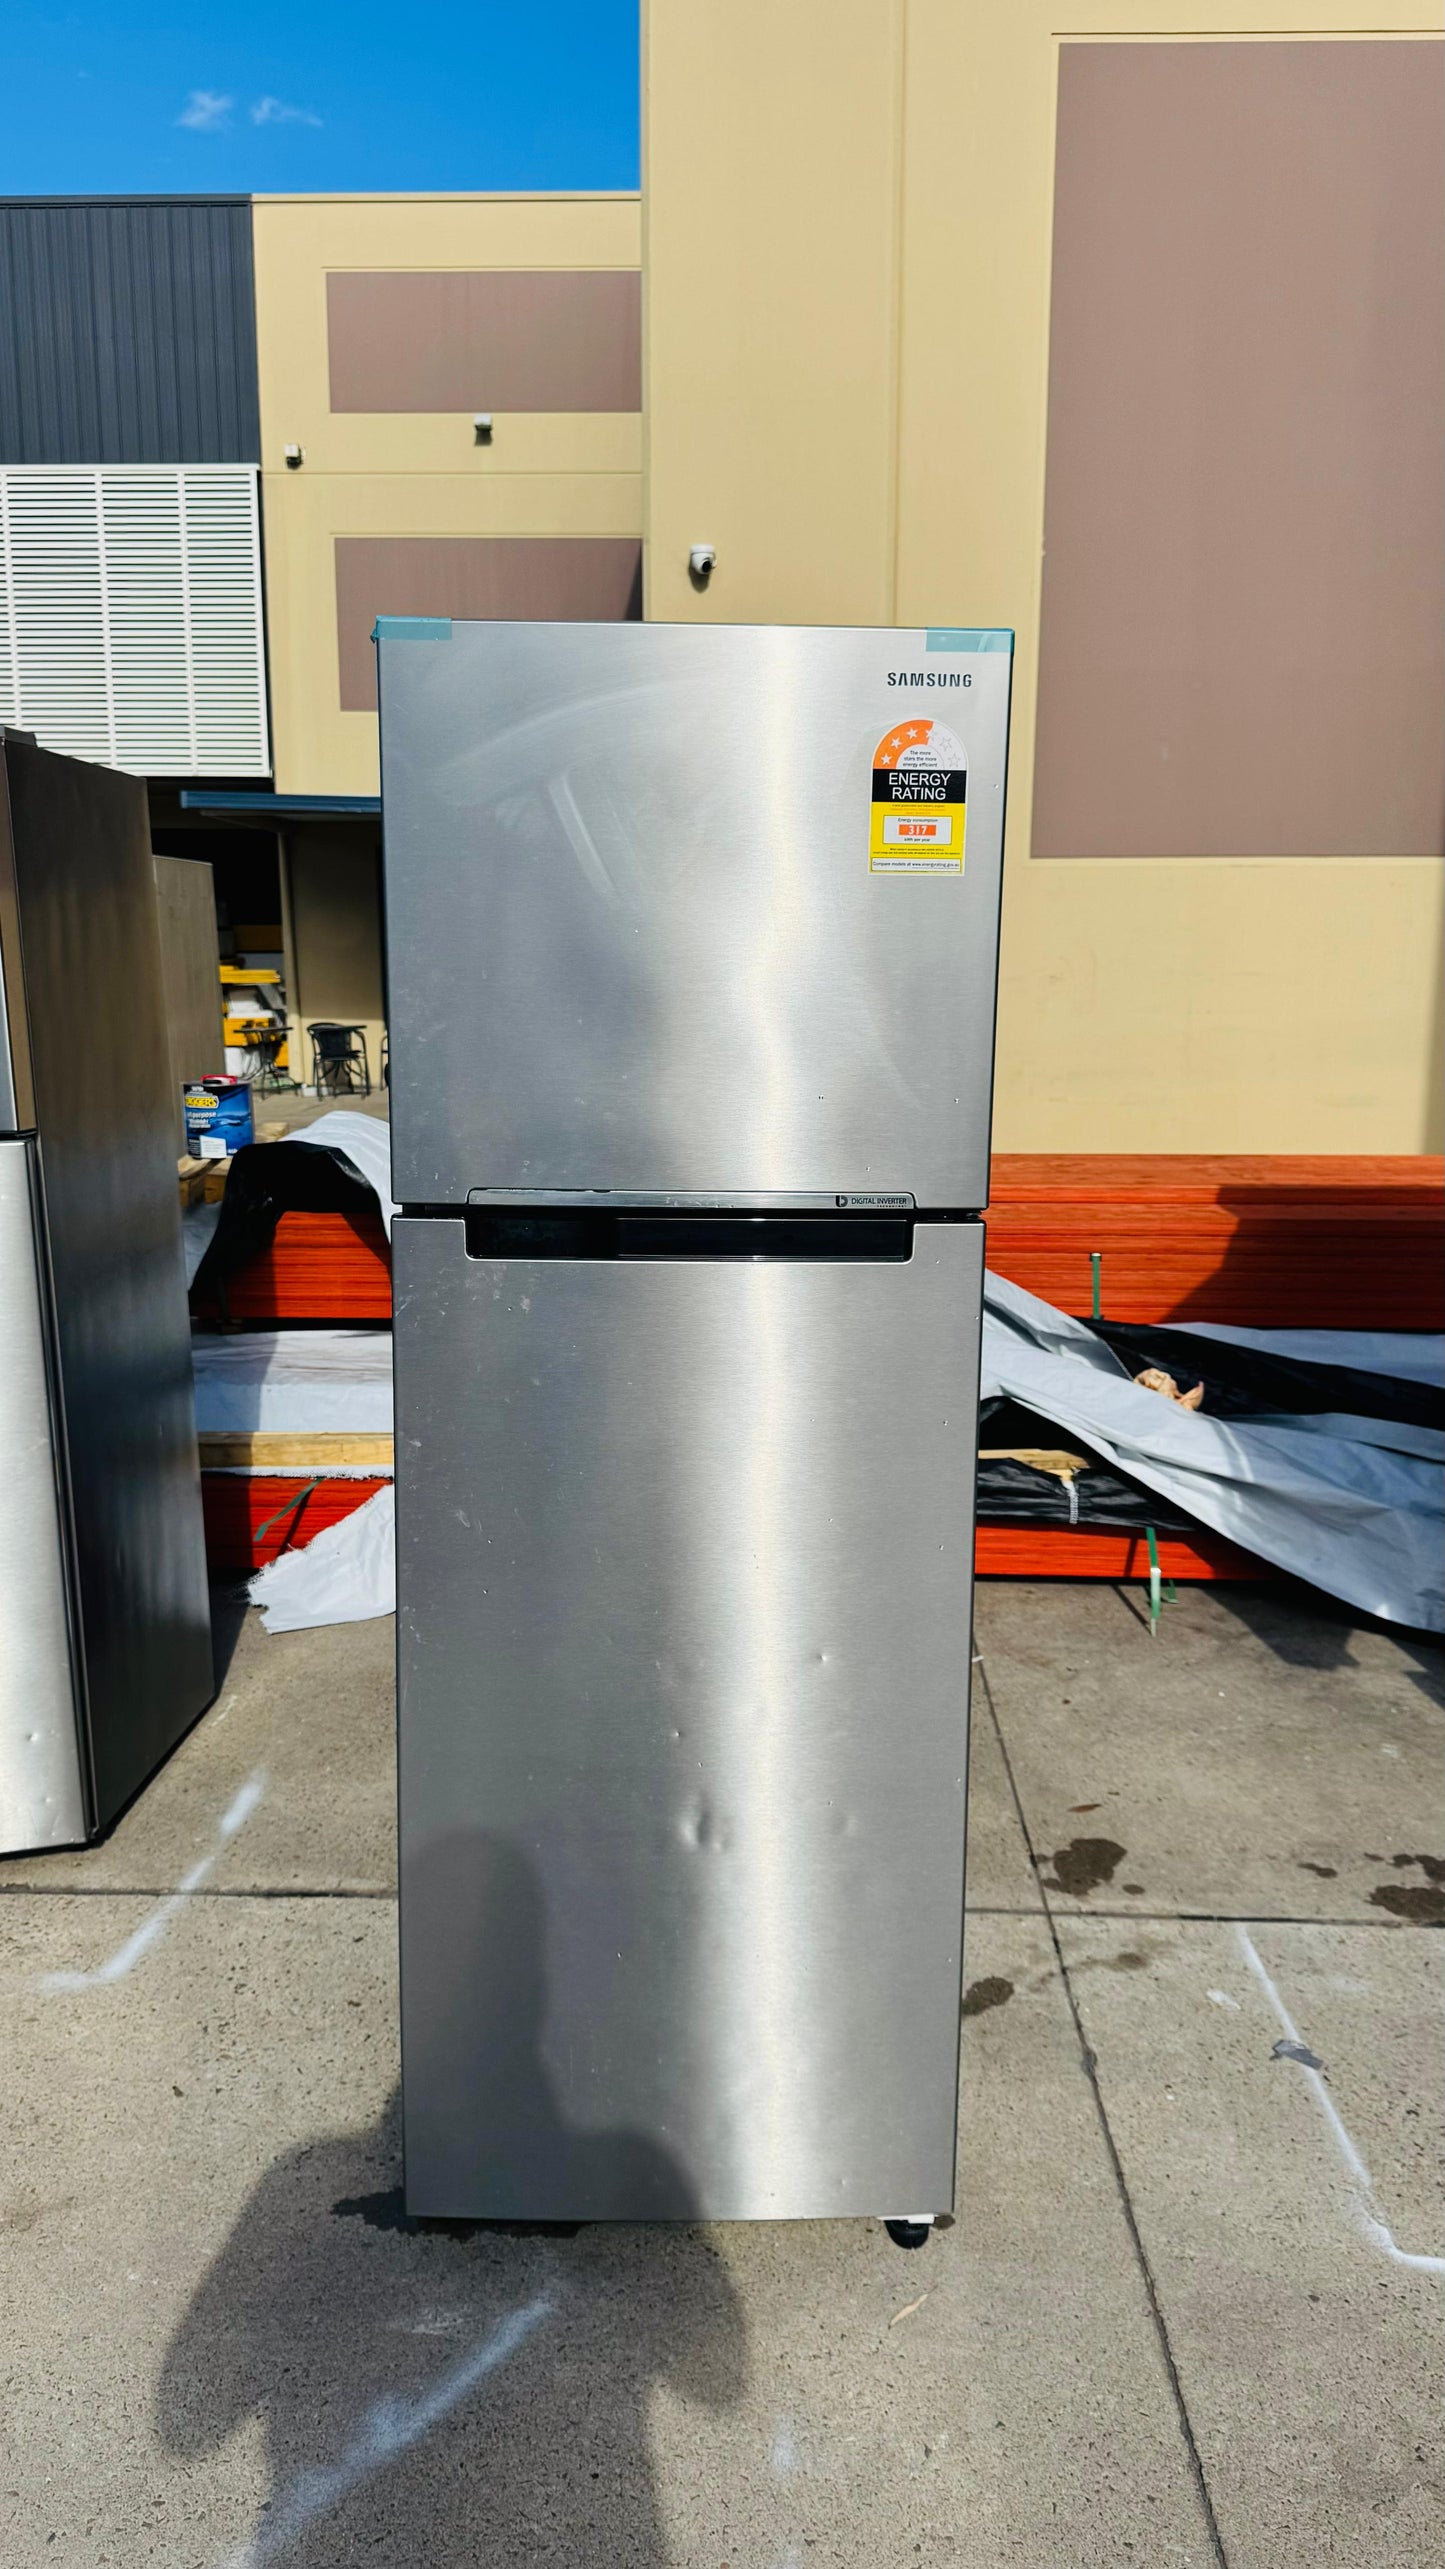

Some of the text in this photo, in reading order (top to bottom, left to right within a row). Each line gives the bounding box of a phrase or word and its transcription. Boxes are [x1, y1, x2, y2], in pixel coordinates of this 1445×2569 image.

[887, 672, 972, 687] SAMSUNG
[888, 772, 951, 786] ENERGY
[892, 787, 946, 800] RATING
[908, 825, 928, 835] 317
